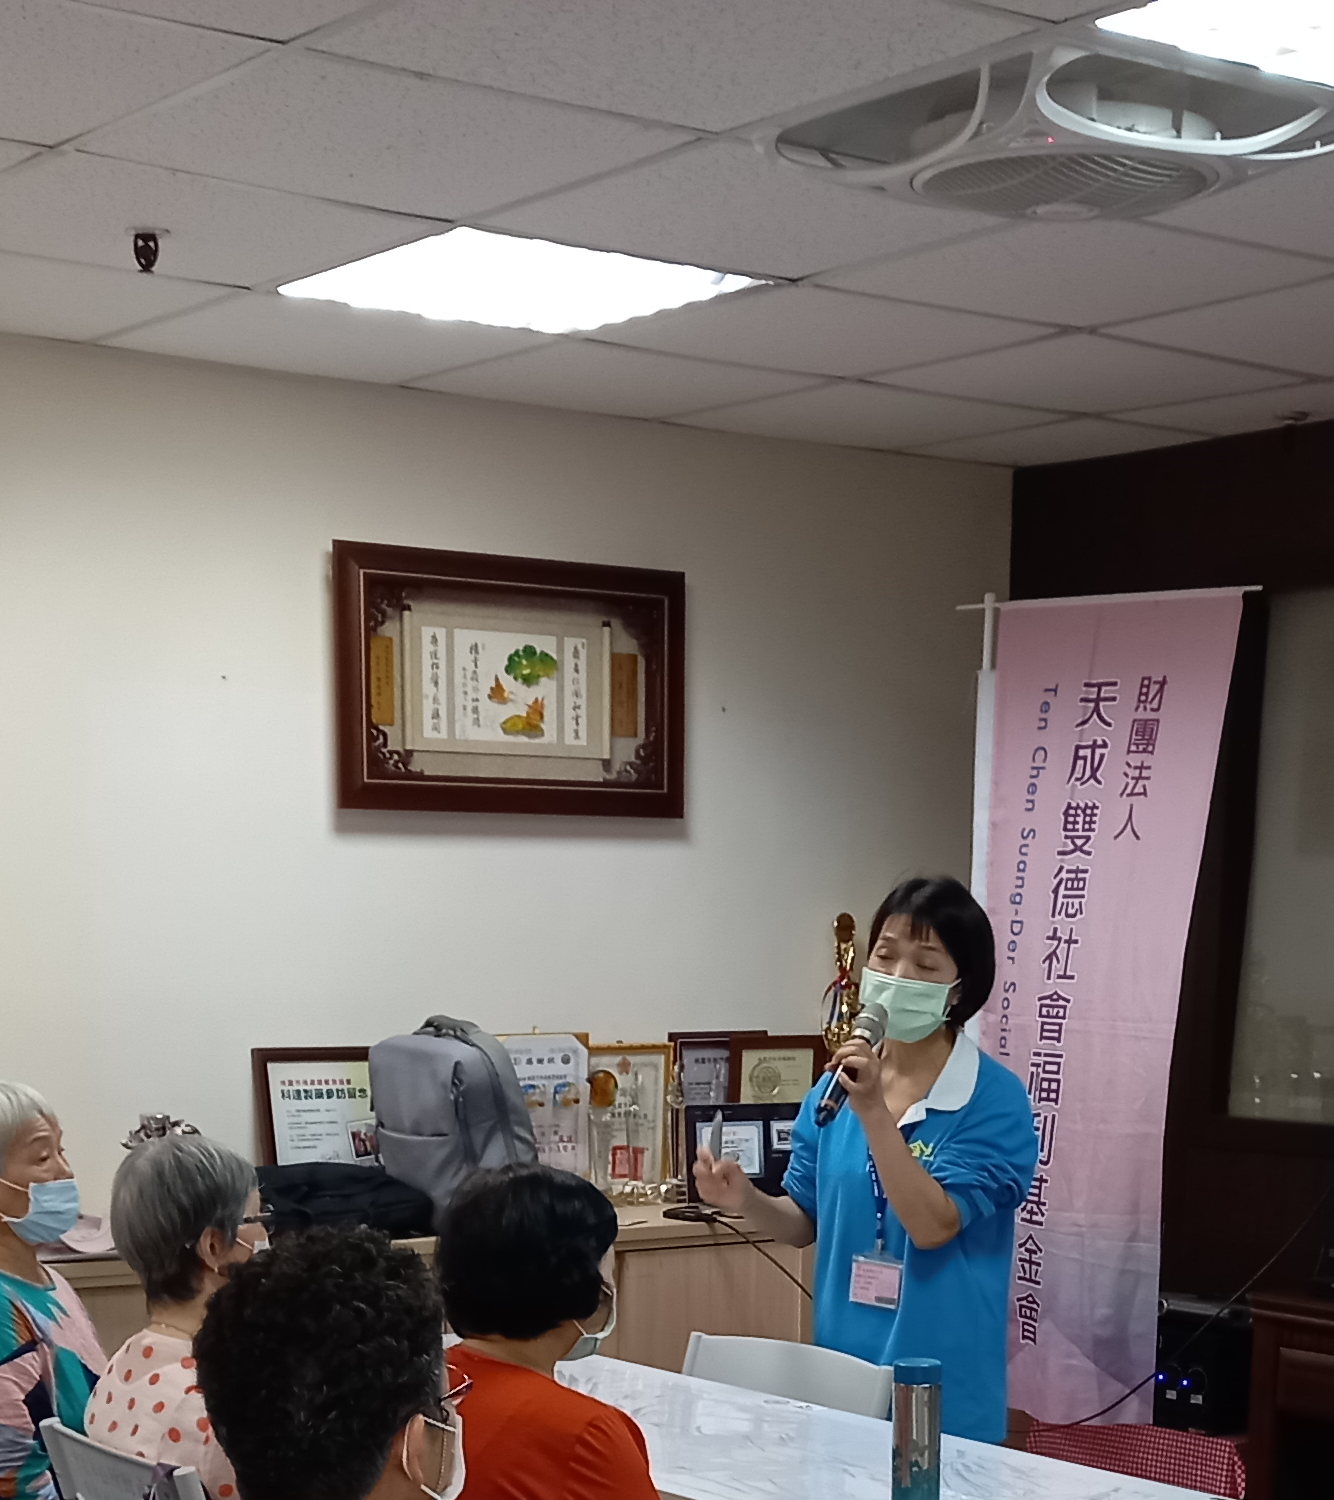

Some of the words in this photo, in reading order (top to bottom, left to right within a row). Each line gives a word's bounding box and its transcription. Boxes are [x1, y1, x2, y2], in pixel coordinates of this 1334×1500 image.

[1036, 683, 1059, 731] Ten
[1023, 745, 1048, 812] Chen
[1113, 674, 1168, 841] 財團法人
[1005, 826, 1037, 965] Suang-Der
[997, 979, 1017, 1057] Social
